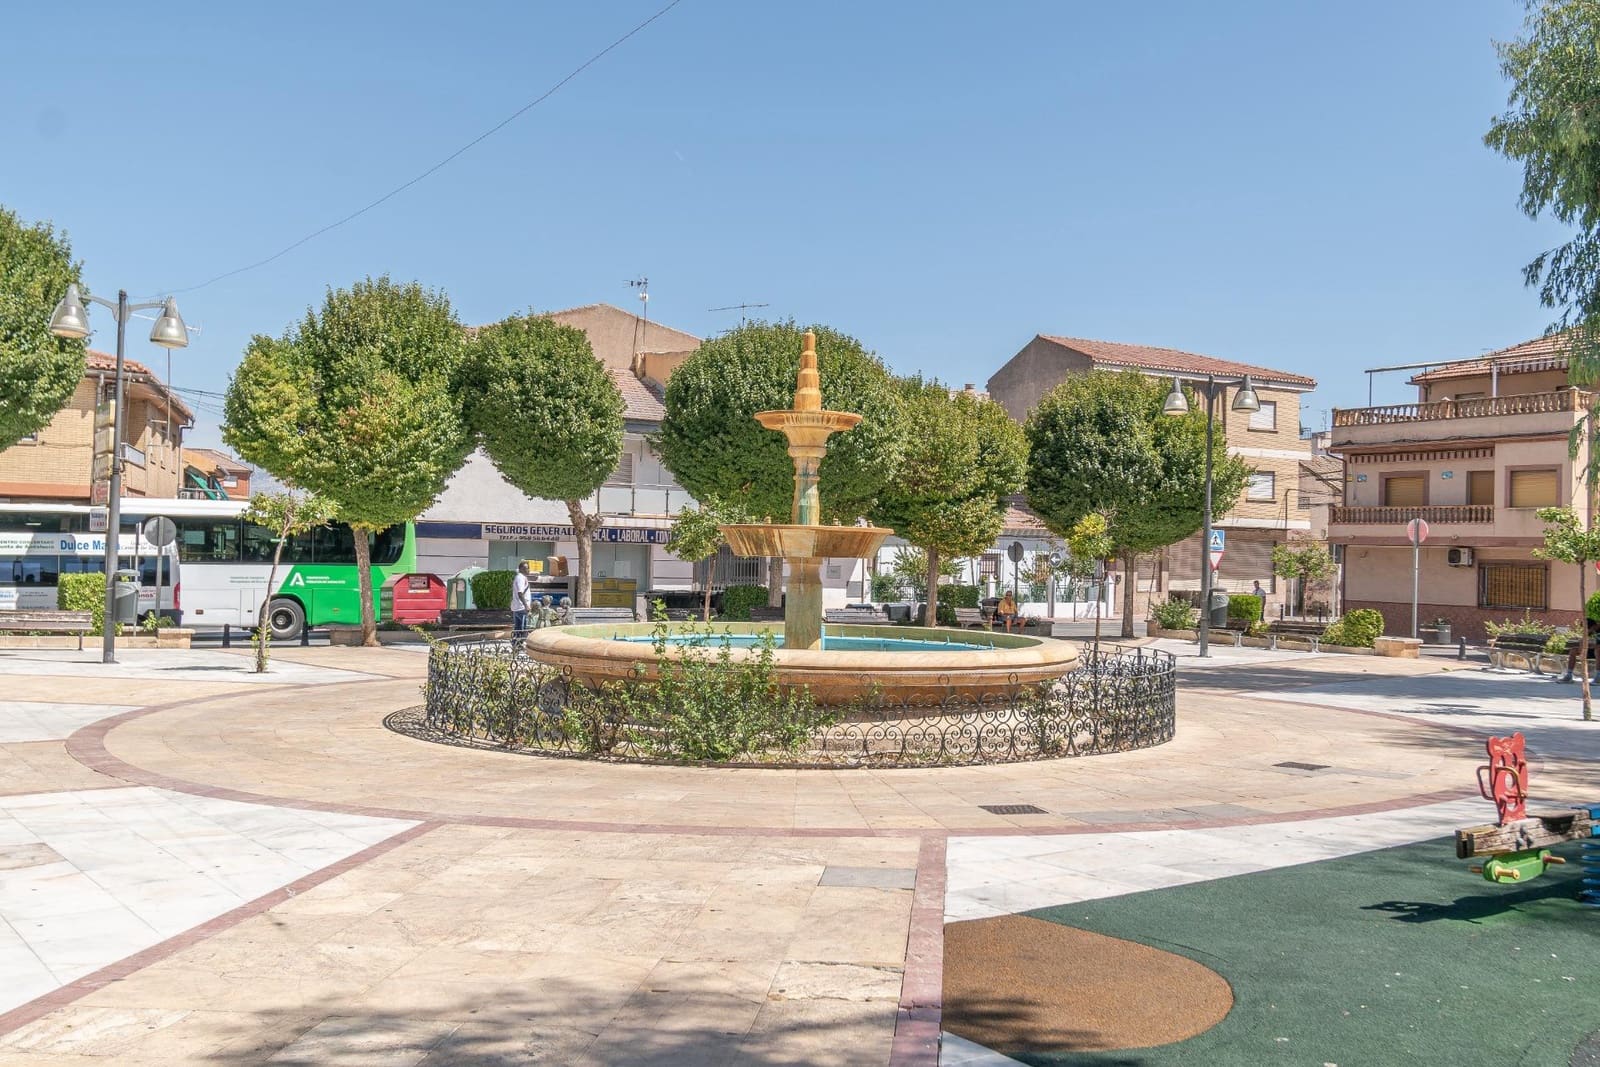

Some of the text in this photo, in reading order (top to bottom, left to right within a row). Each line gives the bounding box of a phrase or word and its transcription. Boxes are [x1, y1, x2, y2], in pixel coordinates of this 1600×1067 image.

[485, 525, 528, 535] SEGUROS
[592, 528, 672, 544] SCAL LABORAL CONT
[60, 539, 89, 550] Dulce
